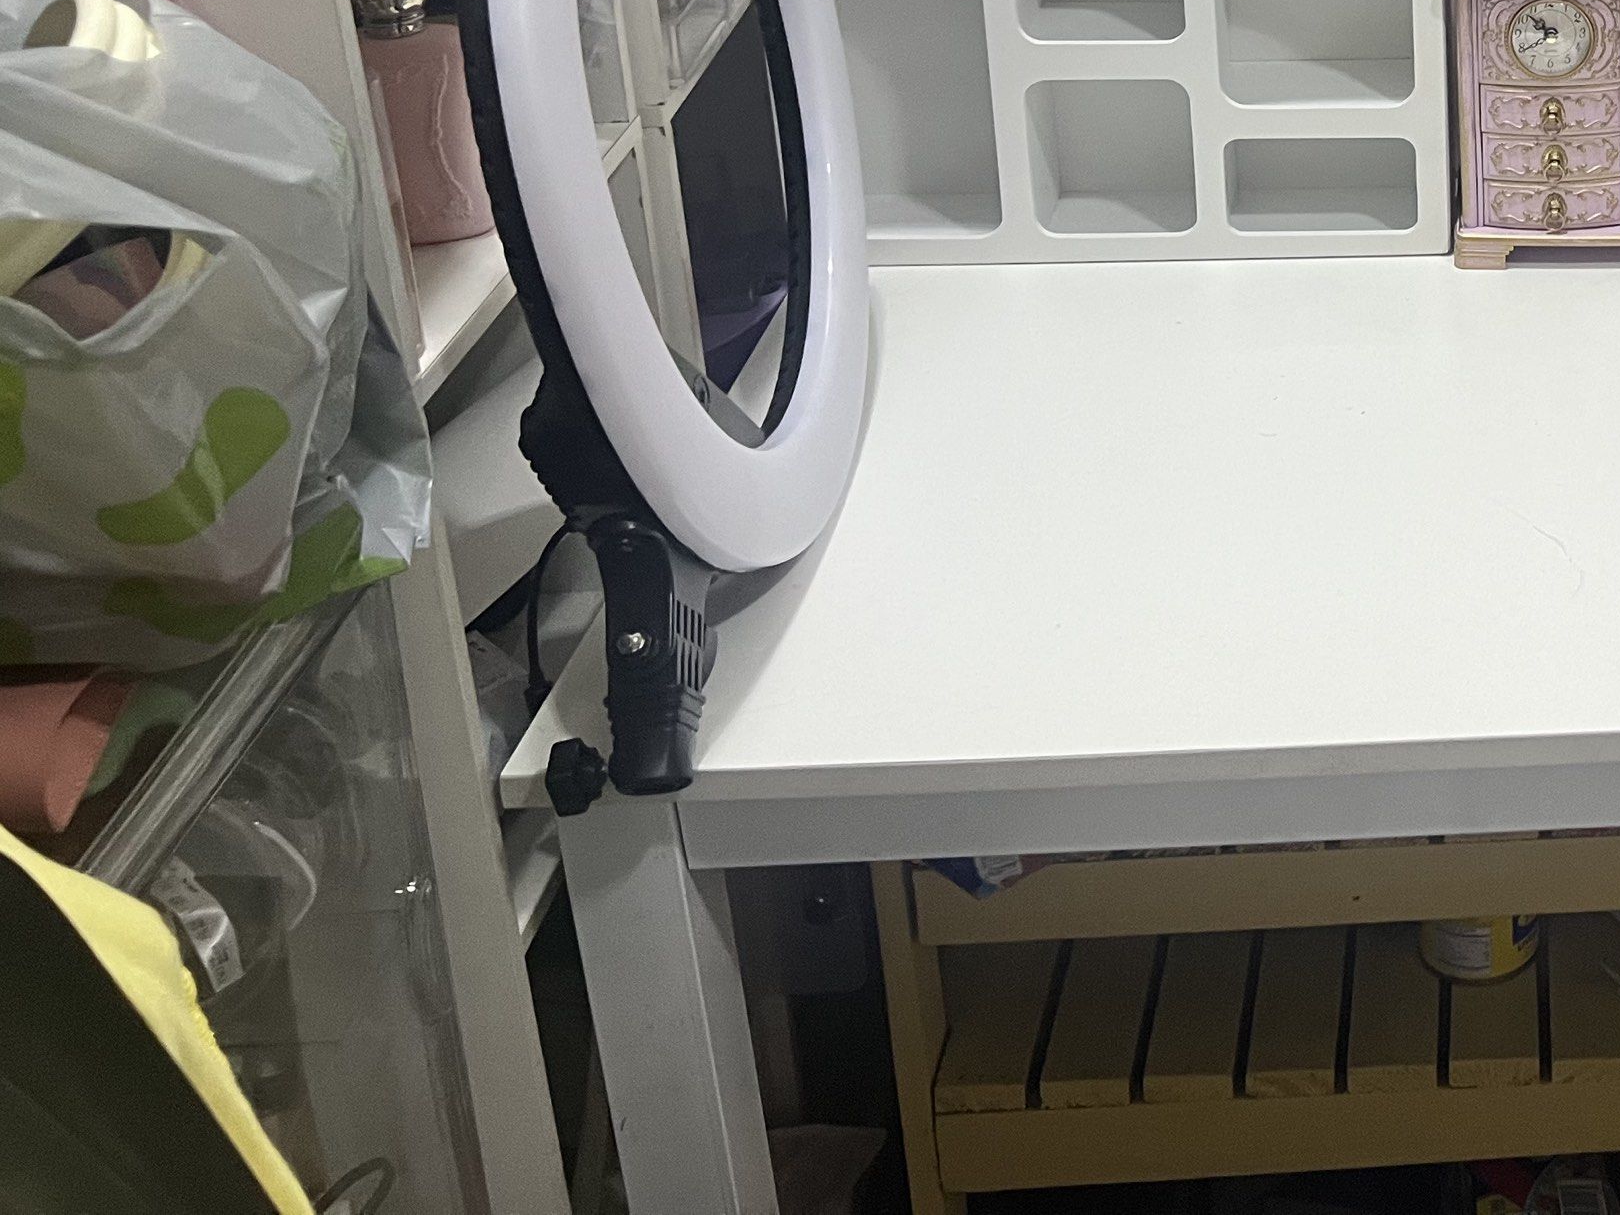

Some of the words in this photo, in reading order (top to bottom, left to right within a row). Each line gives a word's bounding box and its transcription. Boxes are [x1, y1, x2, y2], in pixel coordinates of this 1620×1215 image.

[1515, 14, 1529, 25] 10
[1514, 28, 1522, 39] 9
[1579, 27, 1586, 39] 3
[1529, 55, 1537, 67] 7
[1547, 58, 1554, 68] 6
[1564, 54, 1571, 64] 5
